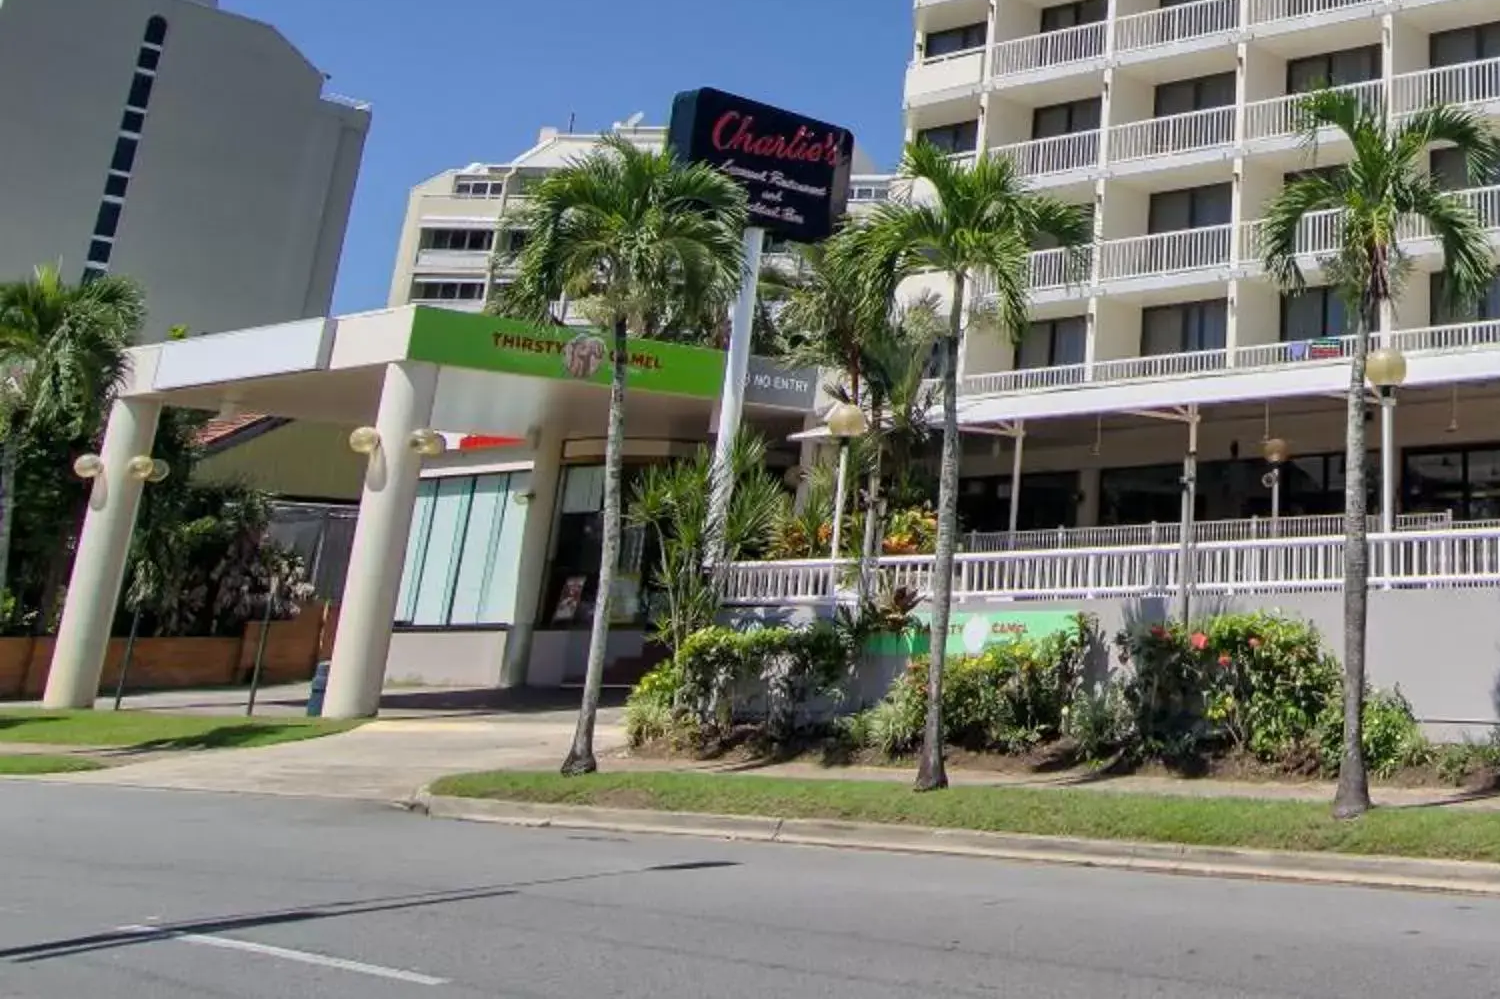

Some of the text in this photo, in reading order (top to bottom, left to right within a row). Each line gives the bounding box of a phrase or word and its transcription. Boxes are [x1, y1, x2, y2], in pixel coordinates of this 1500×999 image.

[712, 110, 838, 168] Charlie's
[492, 332, 565, 354] THIRSTY
[609, 350, 664, 369] CMEL
[753, 373, 809, 393] NO ENTRY
